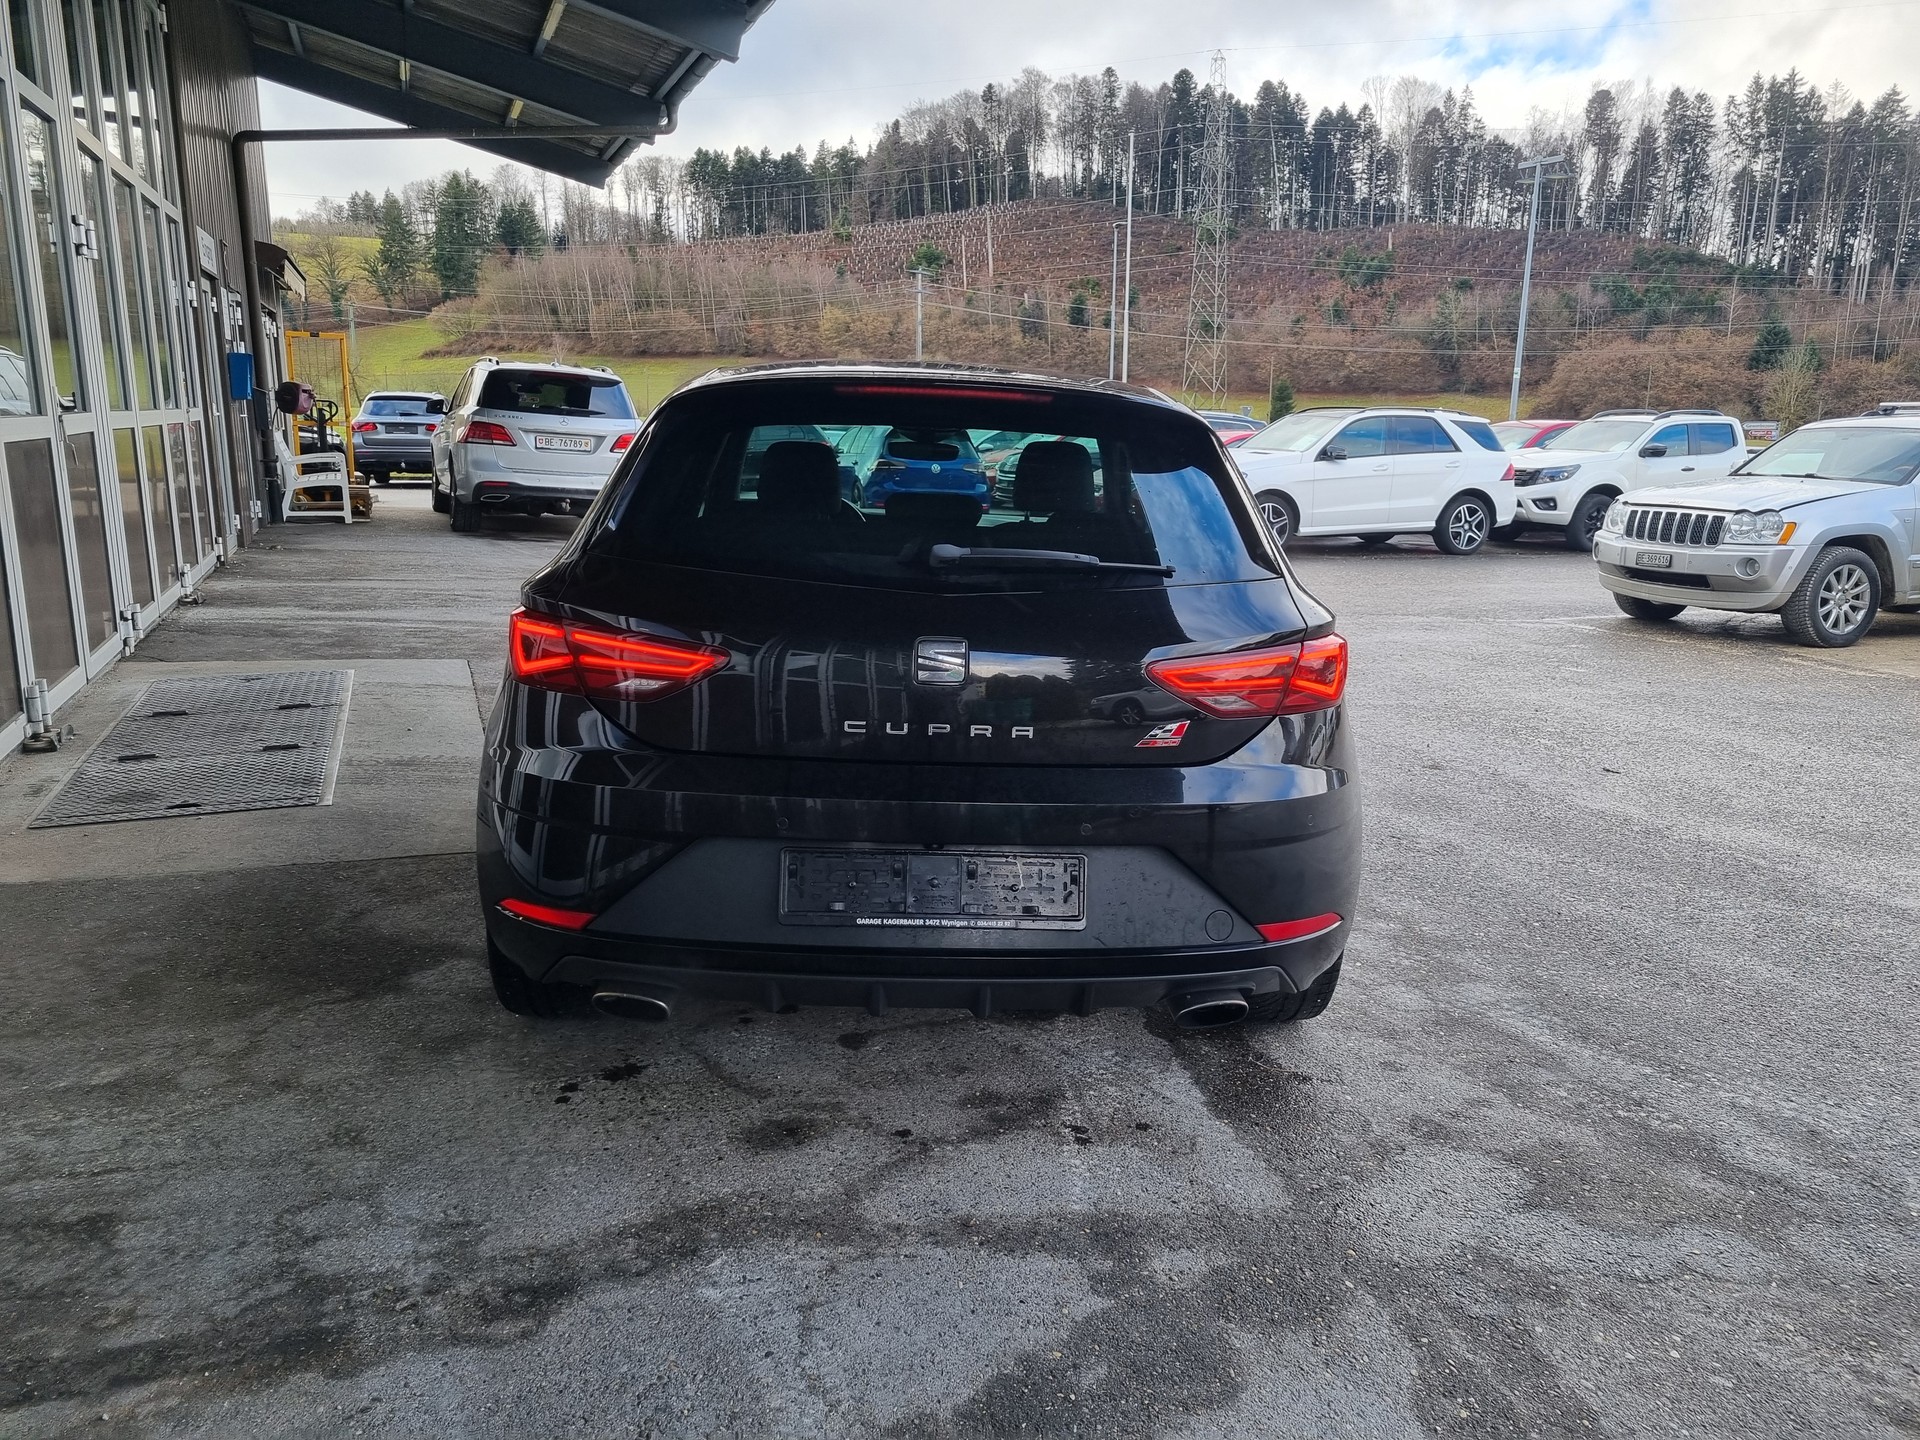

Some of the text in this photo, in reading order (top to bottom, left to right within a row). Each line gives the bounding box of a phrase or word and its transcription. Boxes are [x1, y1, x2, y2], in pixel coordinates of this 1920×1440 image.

[844, 720, 1034, 739] CUPRA
[856, 917, 882, 925] GARAGE
[883, 918, 925, 926] KAGERBAUER
[925, 918, 940, 926] 3472
[941, 919, 968, 928] Wynigen
